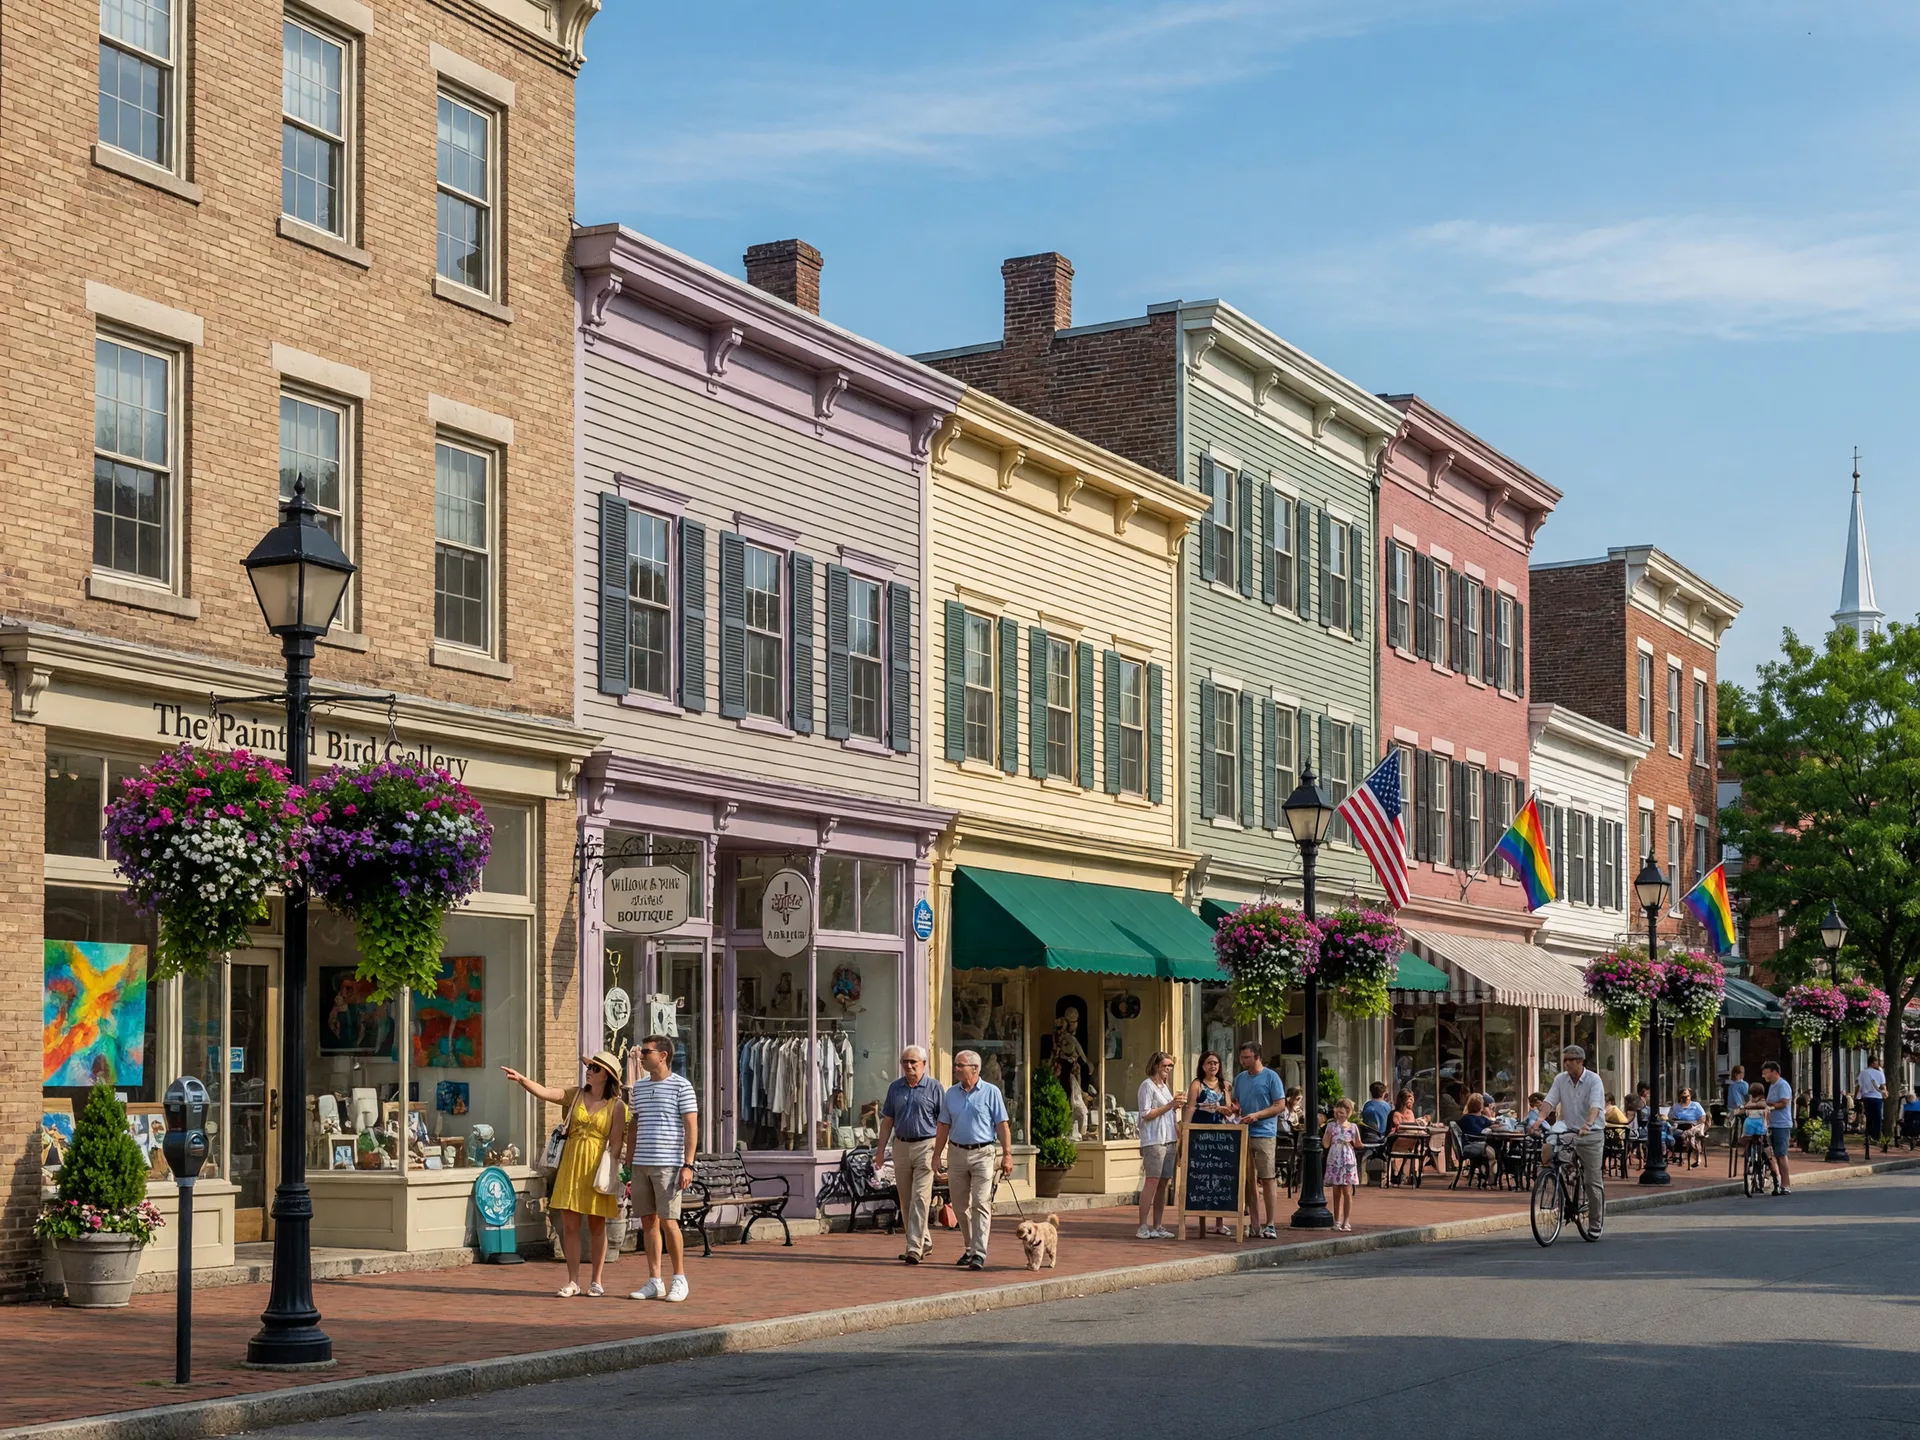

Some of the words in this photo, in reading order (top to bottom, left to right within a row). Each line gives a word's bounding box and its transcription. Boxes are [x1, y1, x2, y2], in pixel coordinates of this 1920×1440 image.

[153, 702, 208, 740] The
[217, 713, 317, 756] Paintd
[326, 730, 377, 764] Bird
[617, 909, 674, 923] BOUTIQUE
